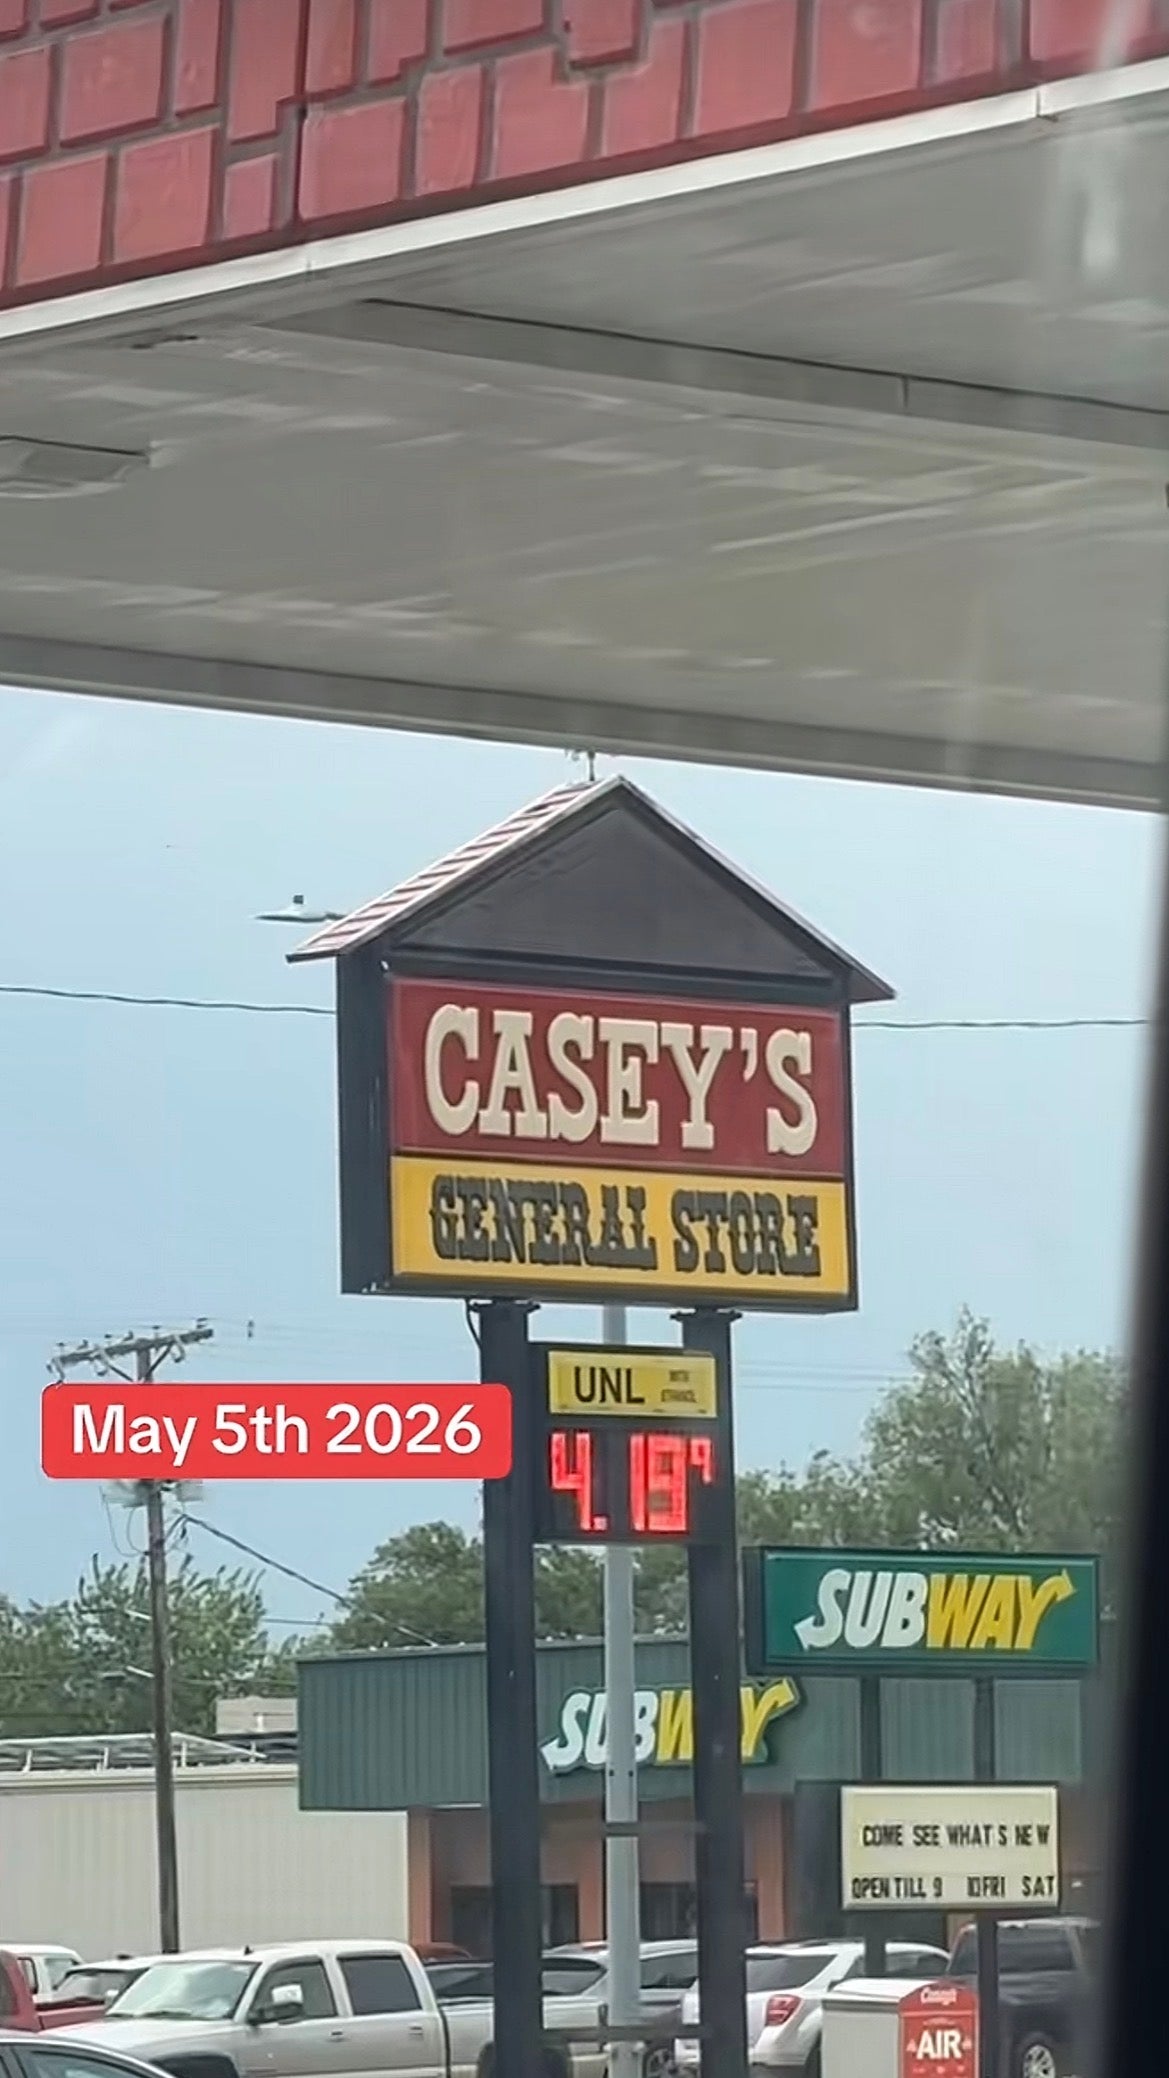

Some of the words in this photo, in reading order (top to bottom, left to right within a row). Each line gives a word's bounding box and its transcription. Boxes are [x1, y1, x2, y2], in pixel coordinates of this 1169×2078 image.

[425, 1003, 818, 1156] CASEY'S
[430, 1174, 659, 1271] GENERAL
[671, 1188, 821, 1277] STORE
[574, 1366, 645, 1404] UNL
[793, 1568, 1076, 1651] SUBWAY
[862, 1825, 903, 1846] COME
[912, 1825, 940, 1846] SEE
[852, 1877, 890, 1899] OPEN
[894, 1877, 927, 1898] TILL
[932, 1877, 943, 1898] 9
[1021, 1876, 1055, 1897] SAT
[916, 2029, 963, 2060] AIR
